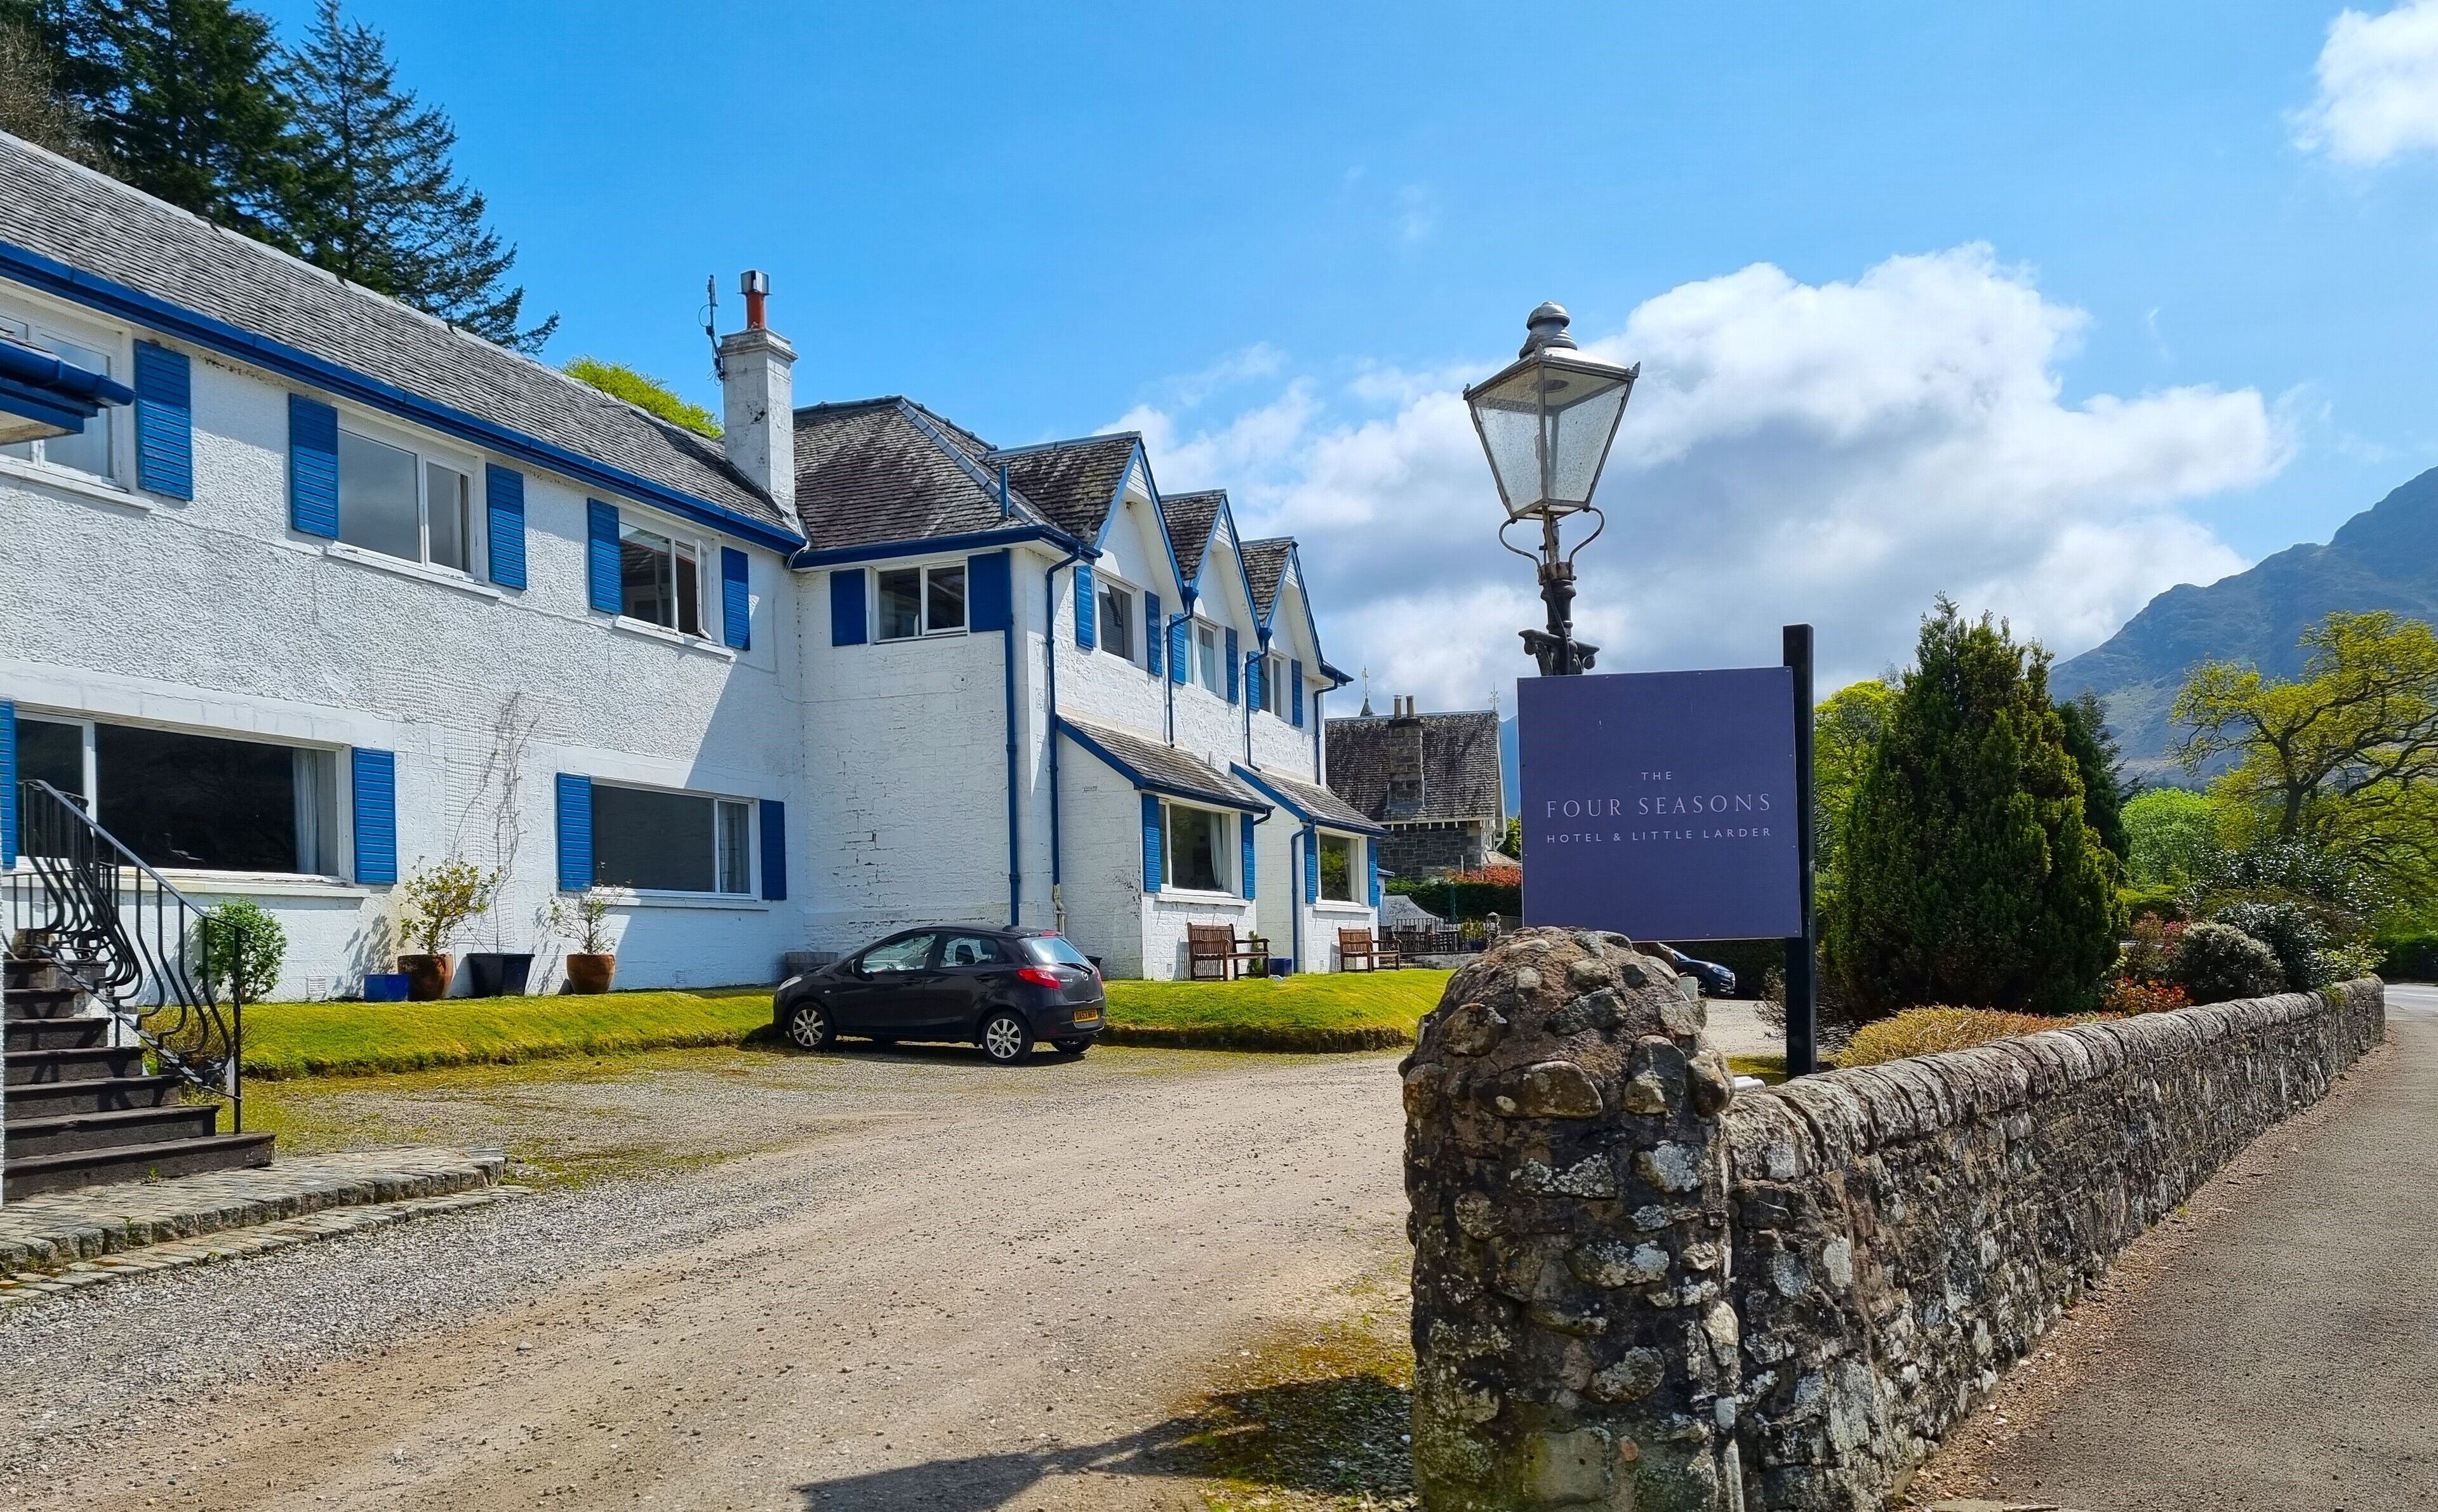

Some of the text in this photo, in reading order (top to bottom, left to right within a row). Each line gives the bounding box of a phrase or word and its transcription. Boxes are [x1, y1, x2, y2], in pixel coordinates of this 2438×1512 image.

[1641, 771, 1672, 781] THE
[1547, 793, 1771, 818] FOUR SEASONS
[1547, 828, 1771, 843] HOTEL & LITTLE LARDER
